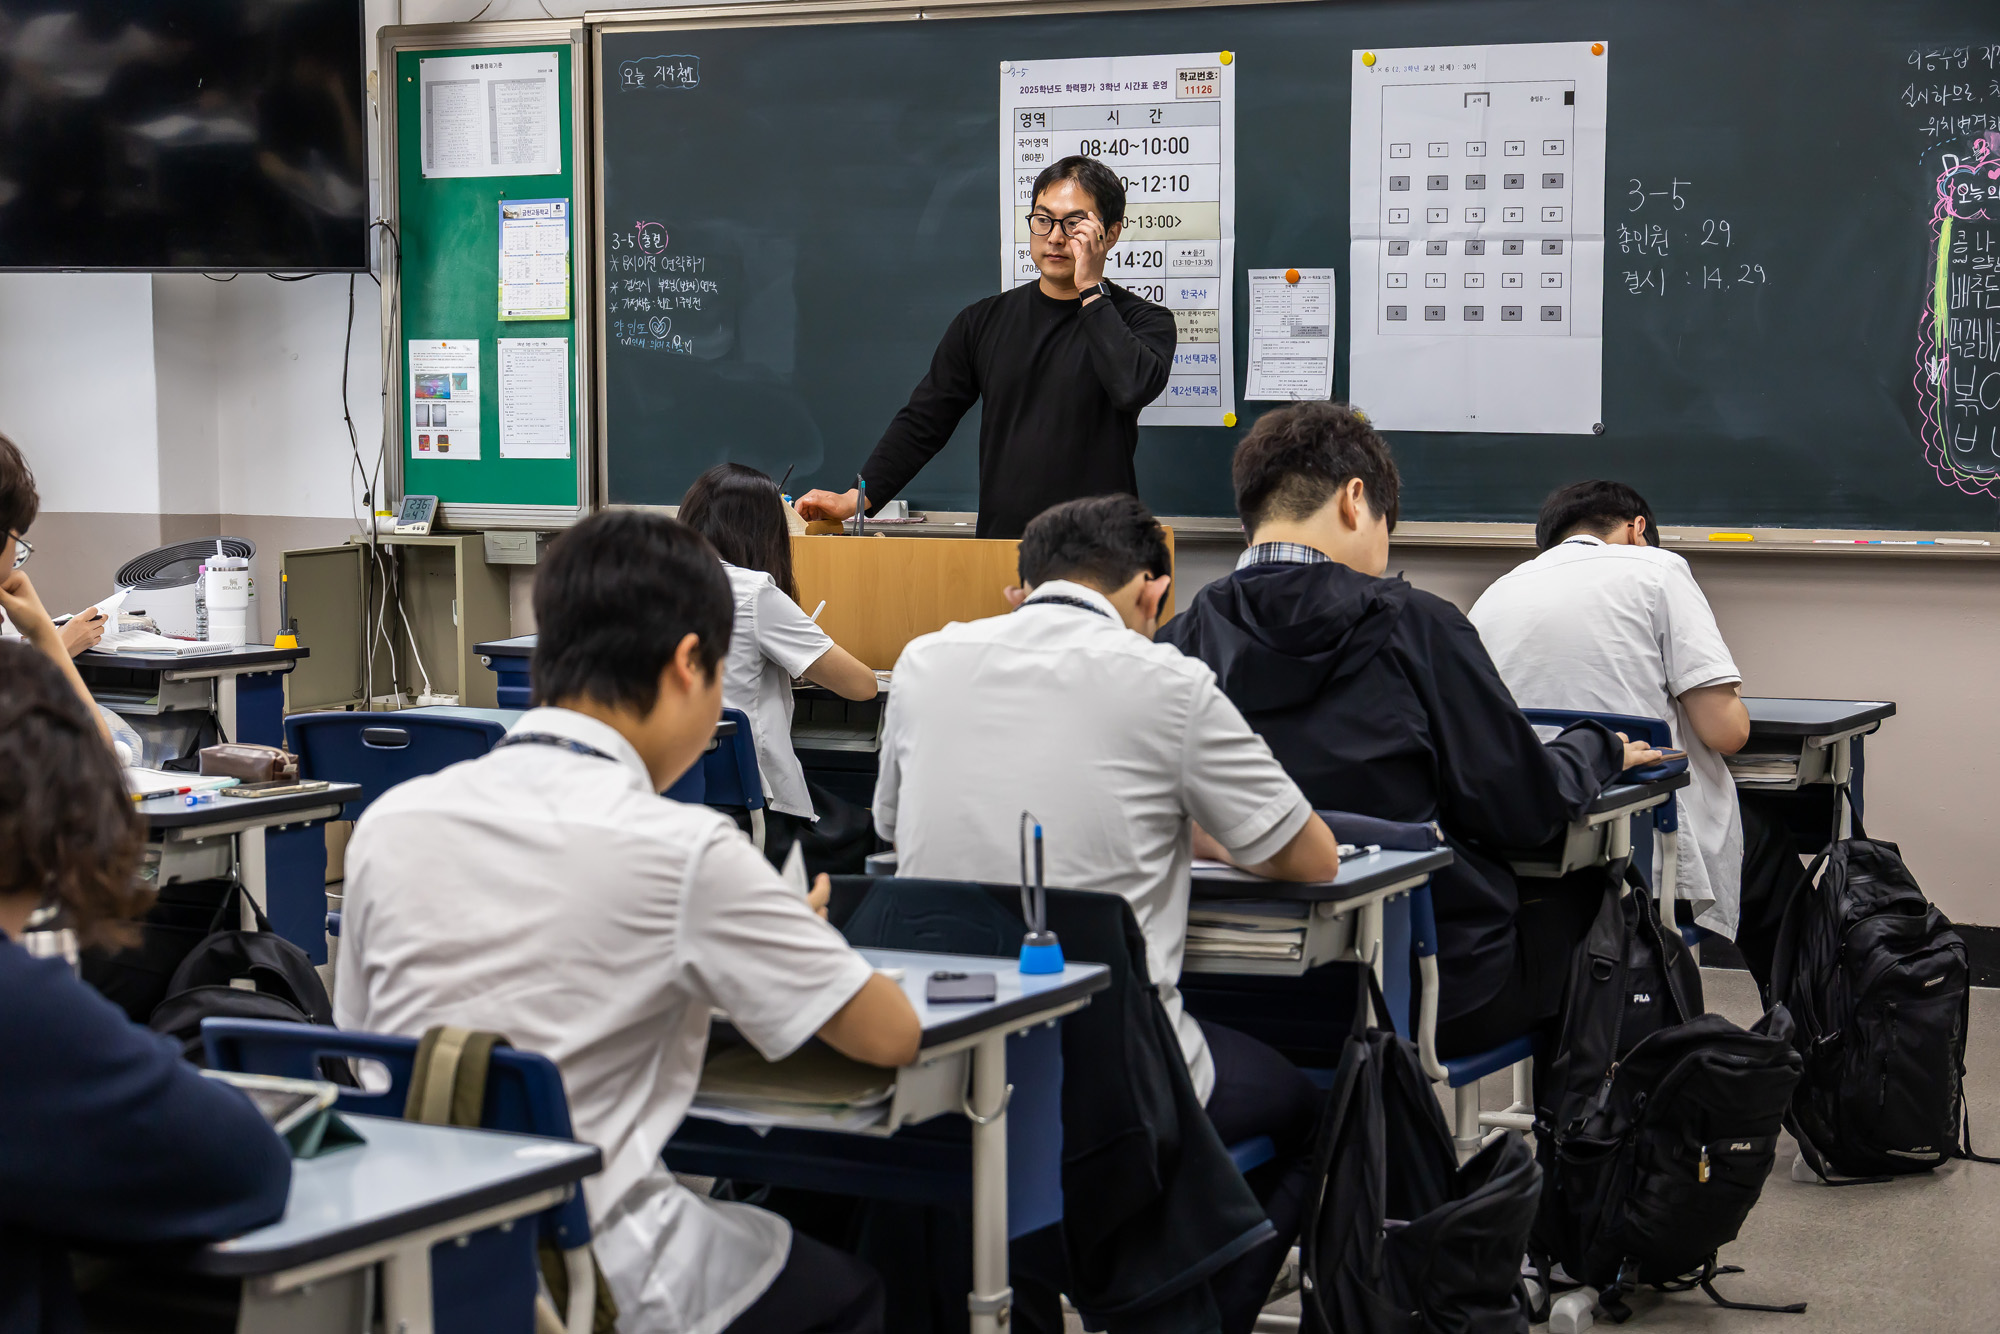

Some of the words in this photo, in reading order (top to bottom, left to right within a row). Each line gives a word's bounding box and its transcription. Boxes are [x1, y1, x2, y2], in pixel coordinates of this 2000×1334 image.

[1011, 67, 1029, 78] 3-5
[1403, 65, 1420, 73] 3학년
[1462, 62, 1477, 71] 30석
[624, 67, 645, 85] 오늘
[1179, 71, 1218, 83] 학교번호:
[1019, 85, 1062, 95] 2025학년도
[1066, 83, 1096, 94] 학력평가
[1100, 82, 1121, 92] 3학년
[1124, 81, 1149, 91] 시간표
[1152, 80, 1169, 90] 운영
[1185, 84, 1213, 95] 11126
[1020, 112, 1047, 129] 영역
[1107, 109, 1119, 126] 시
[1149, 108, 1163, 125] 간
[1018, 138, 1049, 149] 국어영역
[1080, 136, 1189, 157] 08:40~10:00
[1021, 153, 1045, 163] (80분)
[1120, 175, 1189, 193] 0~12:10
[1020, 190, 1034, 199] (10
[1628, 177, 1692, 212] 3-5
[1123, 215, 1182, 229] 0~13:00>
[612, 232, 636, 249] 3-5
[1616, 222, 1669, 256] 총인원
[1106, 250, 1163, 268] ~14:20
[1621, 268, 1665, 297] 결시
[1180, 288, 1207, 300] 한국사
[1949, 317, 2000, 362] 떡갈비
[1170, 385, 1218, 396] 제2선택과목
[1633, 993, 1651, 1003] FILA
[1730, 1141, 1752, 1152] FILA
